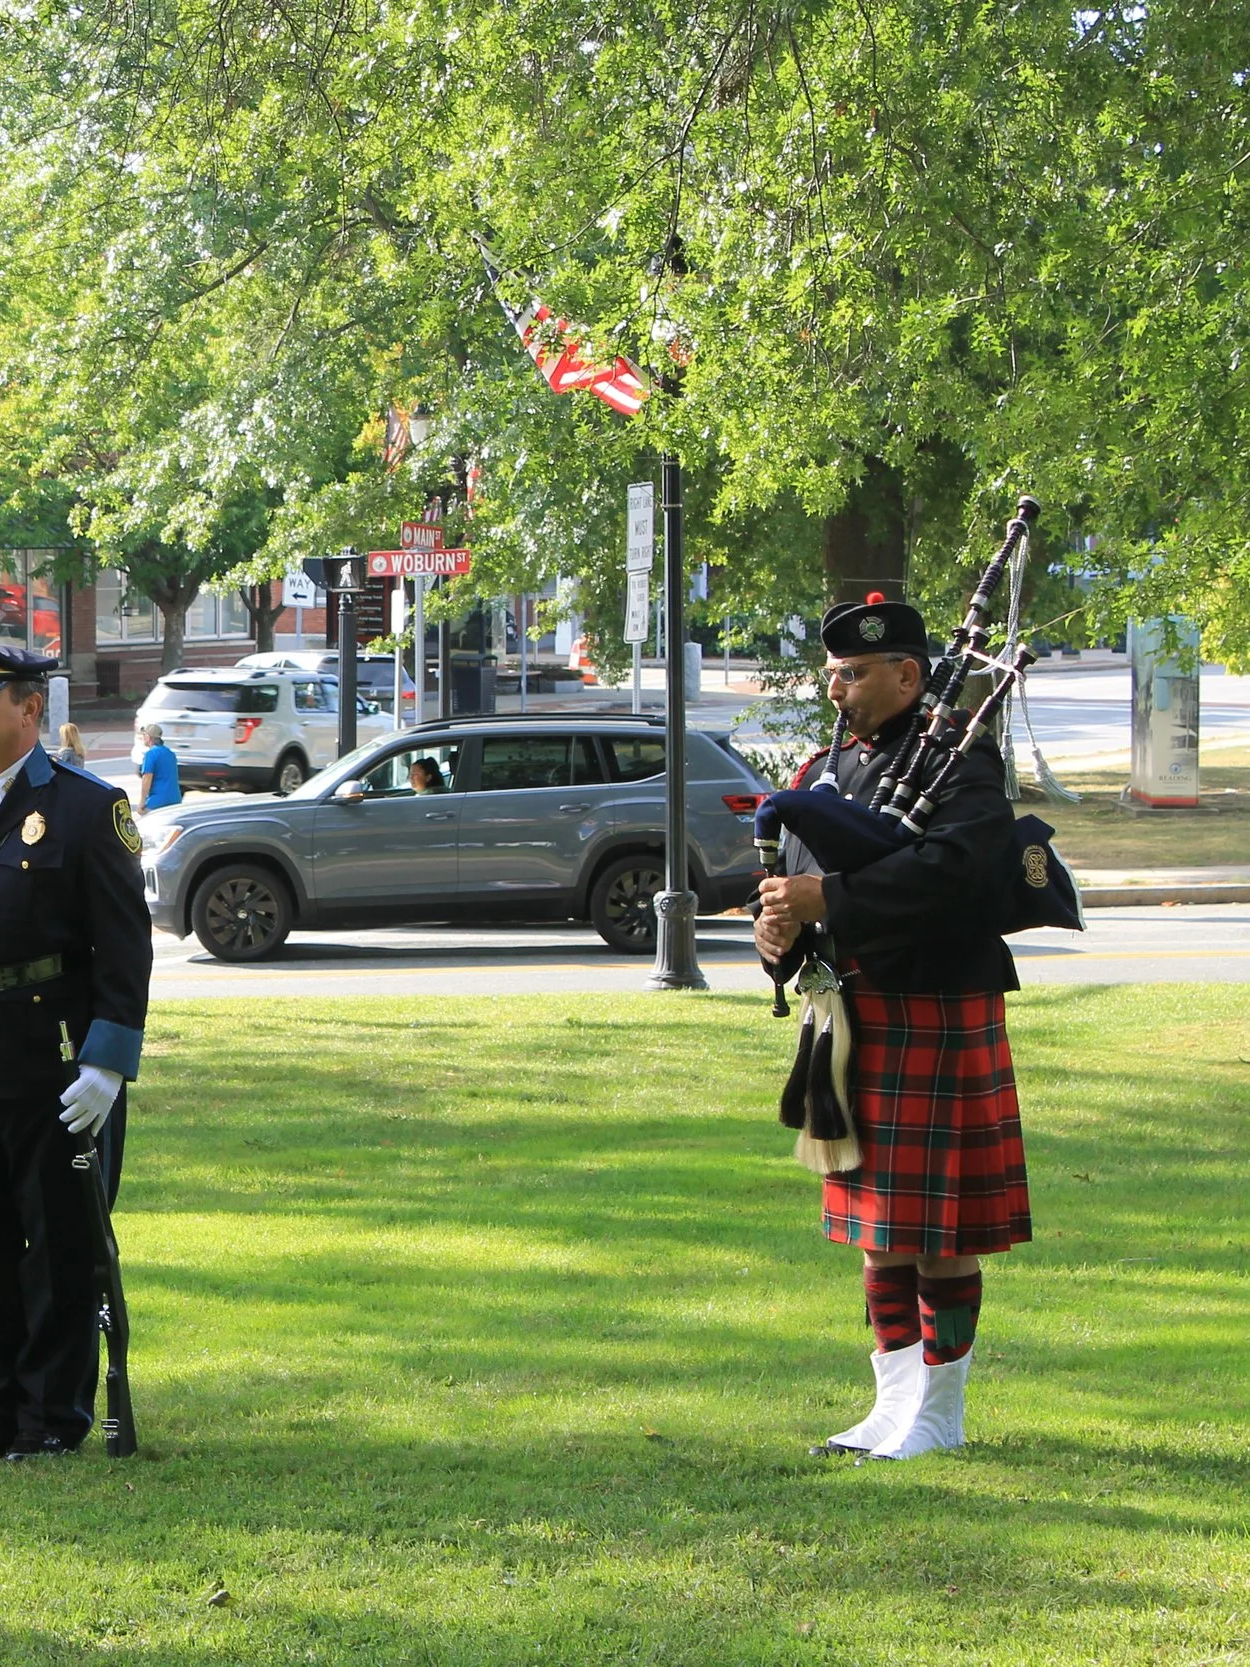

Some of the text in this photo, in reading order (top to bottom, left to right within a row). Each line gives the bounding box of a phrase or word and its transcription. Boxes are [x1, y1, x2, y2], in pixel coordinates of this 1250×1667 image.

[634, 519, 648, 536] MUST
[413, 527, 441, 547] MAIN ST
[391, 552, 466, 573] WOBURN ST
[289, 577, 311, 589] WAY
